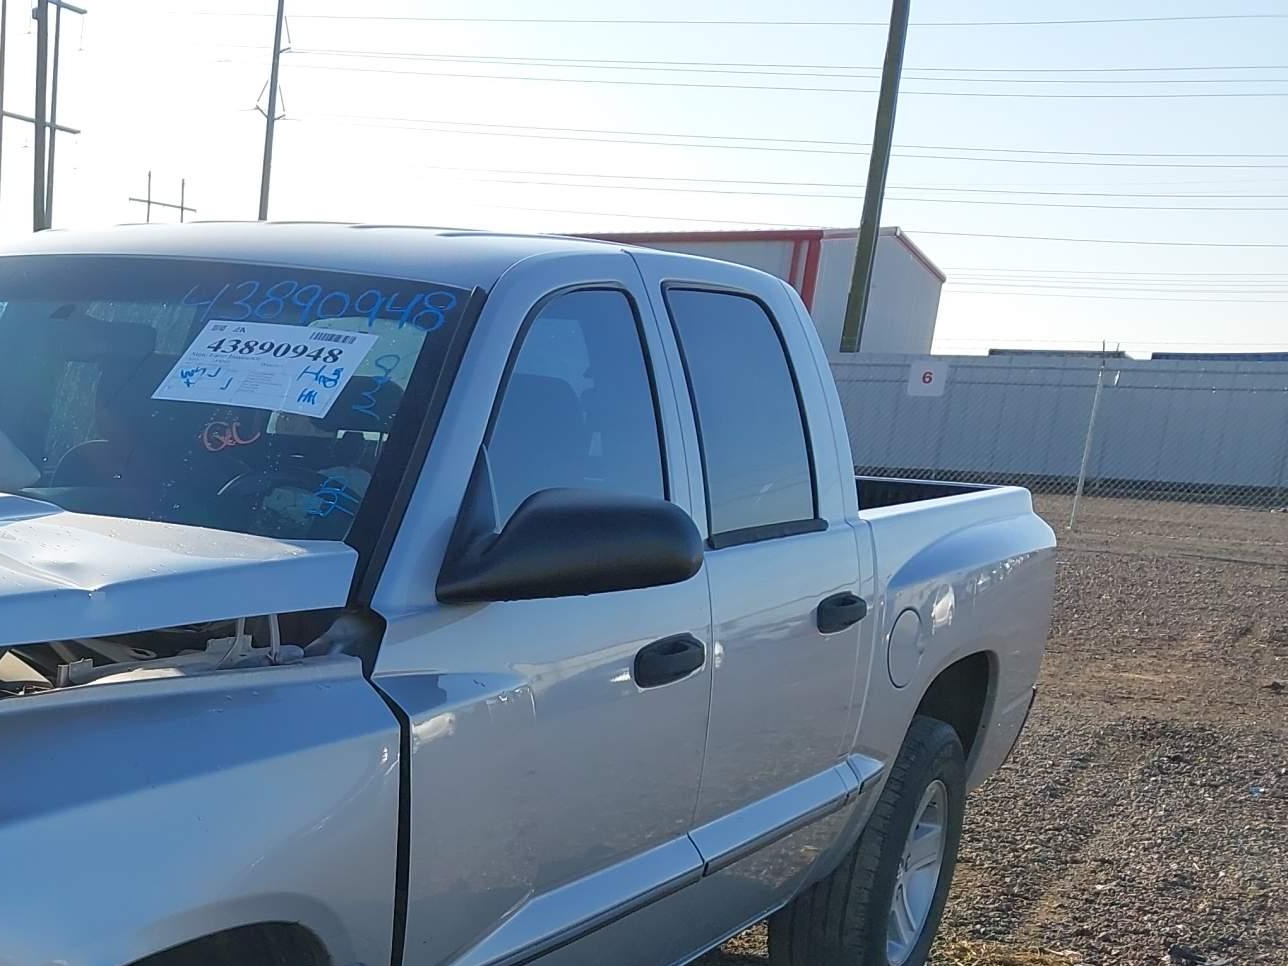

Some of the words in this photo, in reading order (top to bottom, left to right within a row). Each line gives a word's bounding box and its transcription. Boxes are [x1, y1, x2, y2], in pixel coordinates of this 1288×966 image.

[183, 280, 457, 333] 43890948
[207, 338, 344, 364] 43890948
[922, 371, 933, 384] 6
